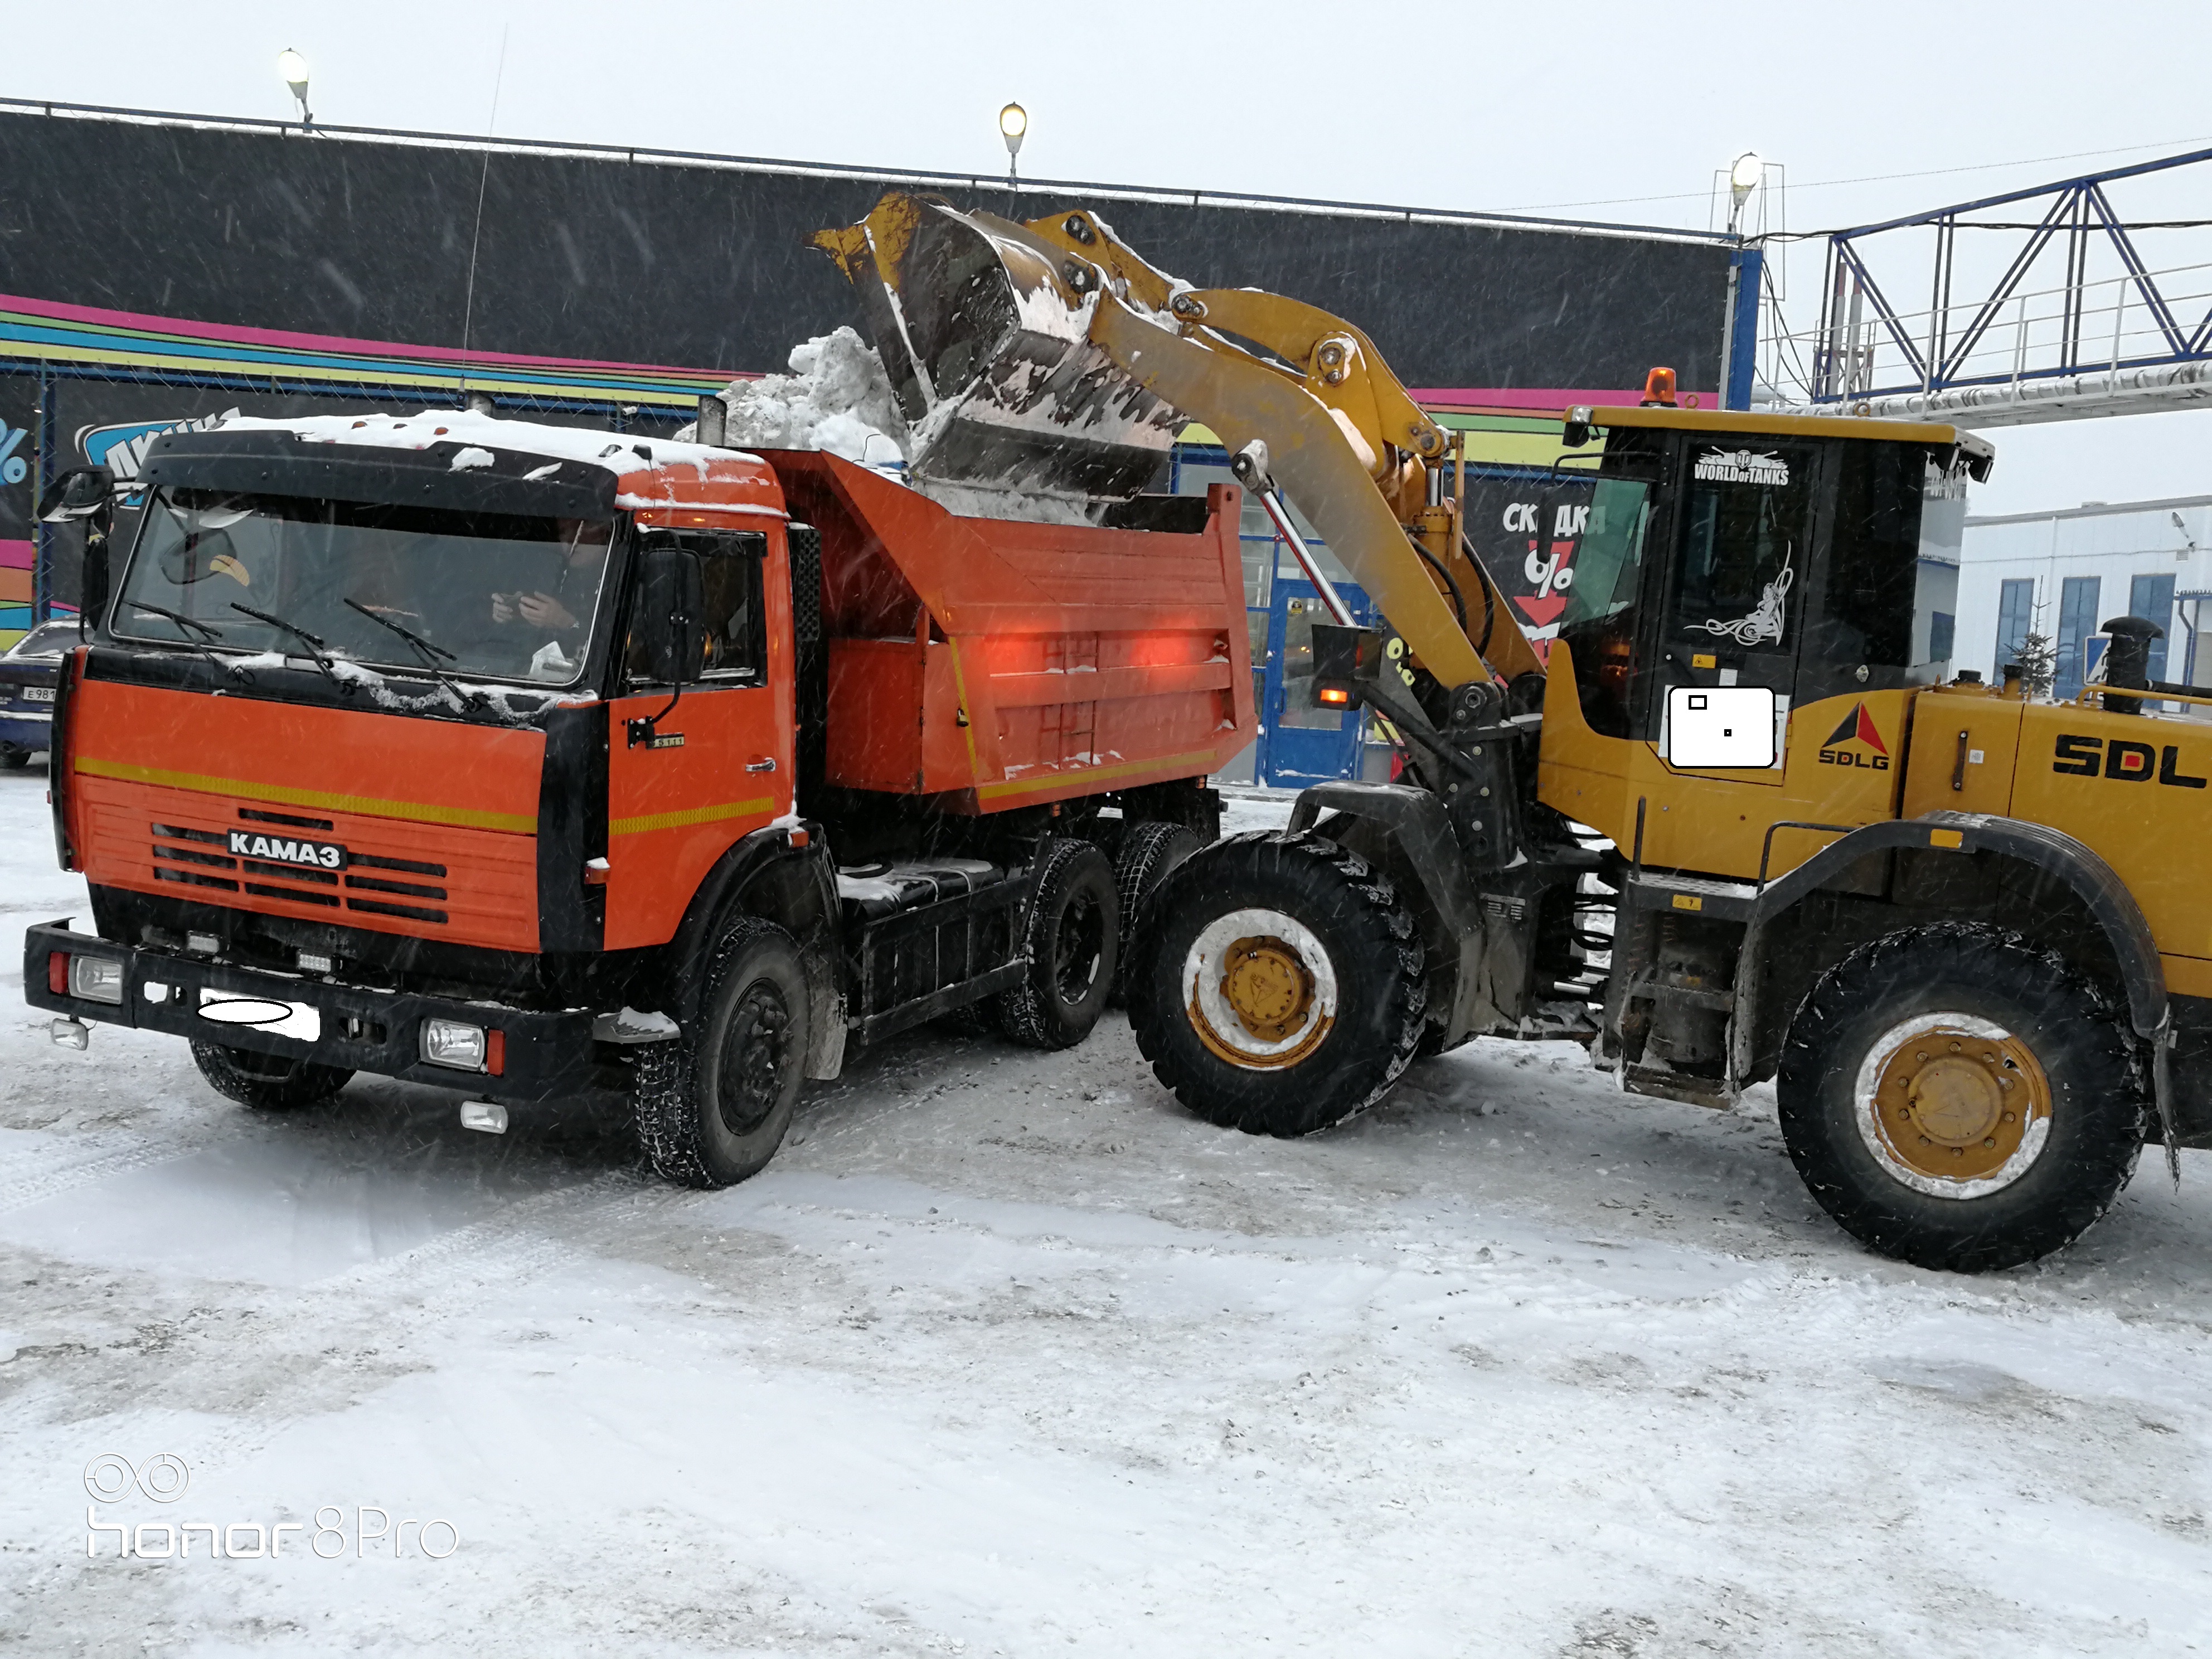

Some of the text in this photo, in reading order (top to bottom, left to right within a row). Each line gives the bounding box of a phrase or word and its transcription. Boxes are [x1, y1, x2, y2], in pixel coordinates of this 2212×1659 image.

[1695, 463, 1789, 486] WORLD OF TANKS
[1502, 502, 1606, 537] СКДКА
[1818, 750, 1890, 770] SDLG
[2053, 734, 2207, 789] SDL
[230, 832, 340, 868] КАМАЗ
